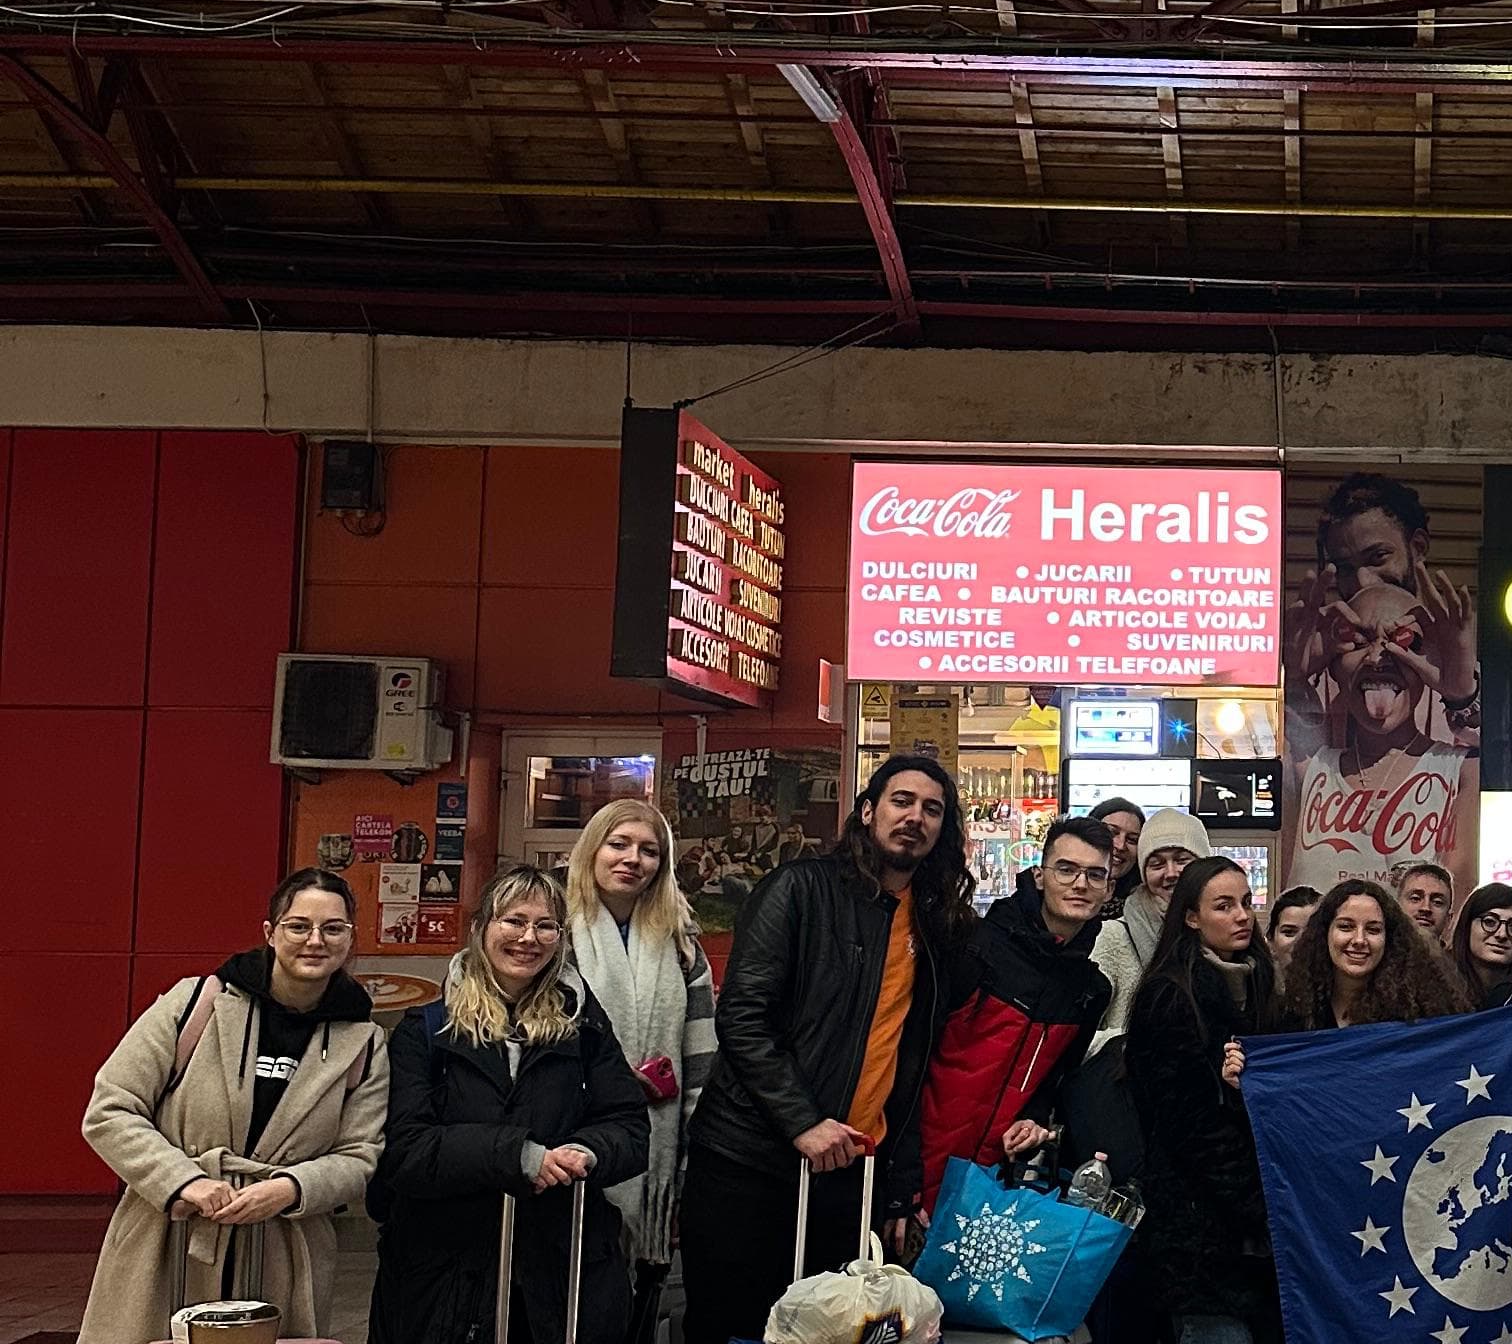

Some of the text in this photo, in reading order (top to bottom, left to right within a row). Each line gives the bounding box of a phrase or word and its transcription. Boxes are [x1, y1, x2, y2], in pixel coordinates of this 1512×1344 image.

[693, 440, 785, 525] market heralis
[689, 475, 729, 523] DULCIURI
[731, 499, 754, 541] CAFEA
[859, 486, 1270, 544] Coca-Cola Heralis
[686, 512, 782, 591] BAUTURI RACORITOARE
[862, 561, 1271, 585] DULCIURI JUCARII TUTUN
[861, 584, 1274, 608] CAFEA BAUTURI RACORITOARE
[680, 590, 722, 633] ARTICOLE
[899, 608, 1266, 631] REVISTE ARTICOLE VOIAJ
[874, 630, 1274, 652] COSMETICE SUVENIRURI
[938, 655, 1217, 676] ACCESORII TELEFOANE
[674, 768, 688, 779] PE
